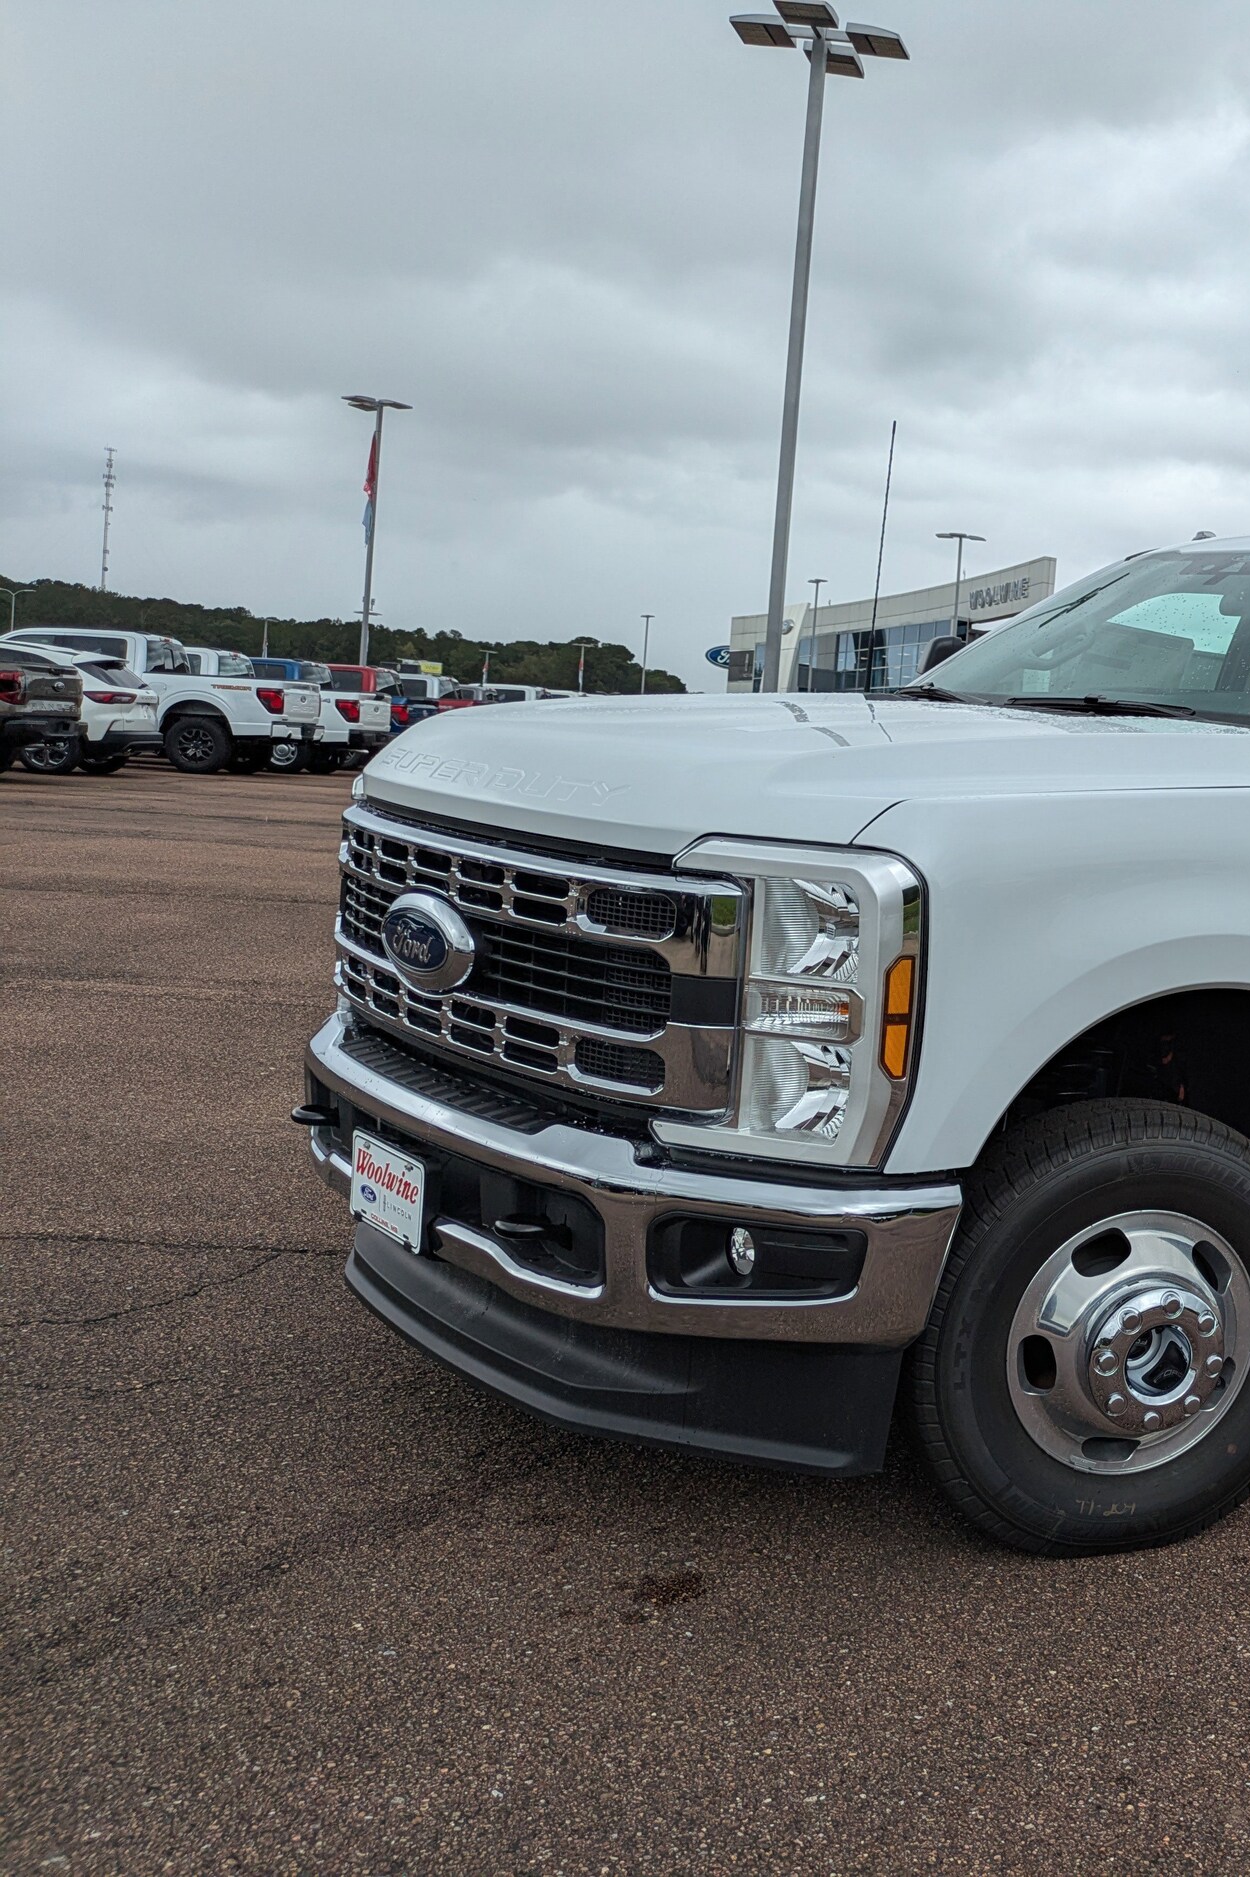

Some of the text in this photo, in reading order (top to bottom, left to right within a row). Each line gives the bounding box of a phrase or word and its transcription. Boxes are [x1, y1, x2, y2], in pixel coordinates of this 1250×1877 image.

[969, 577, 1030, 611] WOOLWINE
[382, 748, 633, 807] SUPER DUTY
[393, 917, 435, 963] Ford
[356, 1148, 419, 1204] Woolwine
[386, 1201, 412, 1221] LINCOLN
